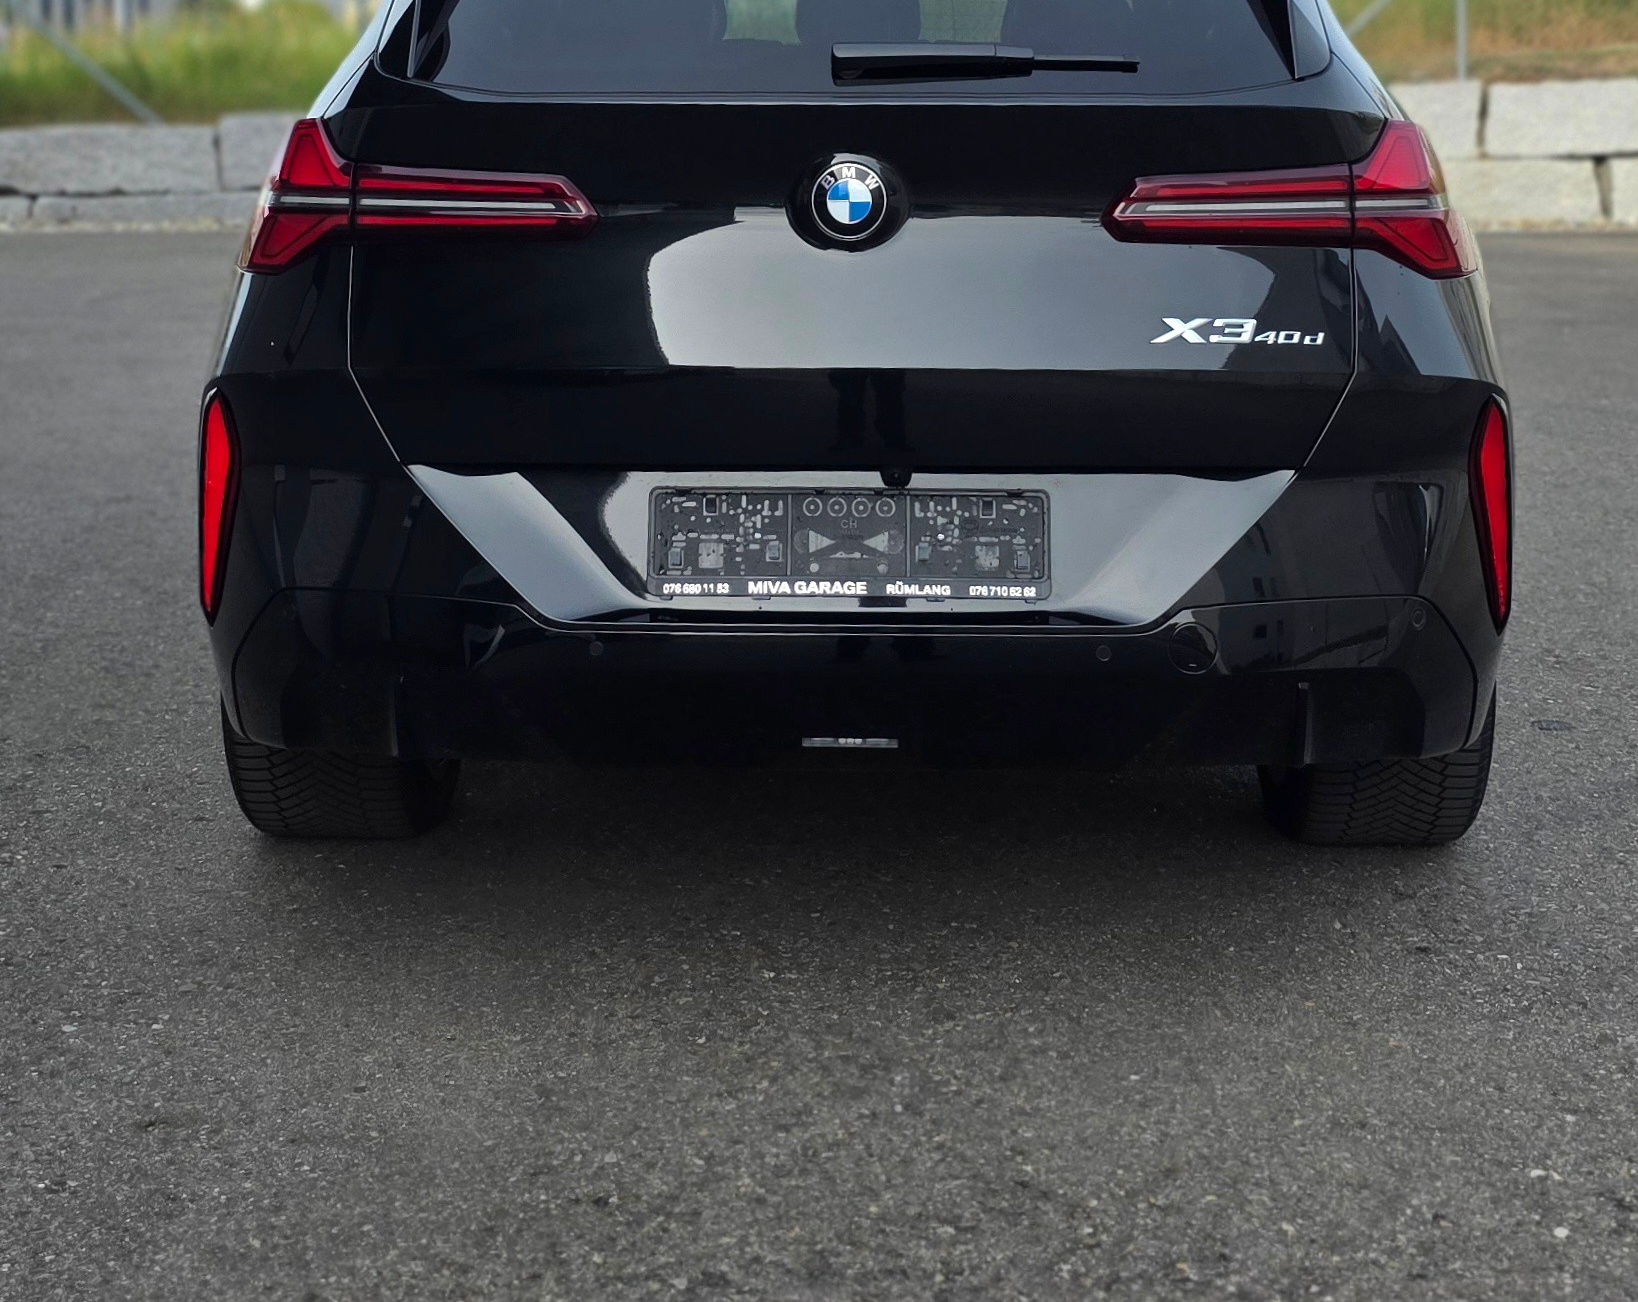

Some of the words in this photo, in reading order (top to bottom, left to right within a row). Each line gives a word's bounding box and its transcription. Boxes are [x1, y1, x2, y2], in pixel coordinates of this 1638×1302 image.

[820, 166, 880, 191] BMW
[663, 583, 682, 595] 076
[702, 583, 714, 594] 11
[747, 581, 791, 595] MIVA
[794, 581, 868, 595] GARAGE
[885, 581, 951, 596] RÜMLANG
